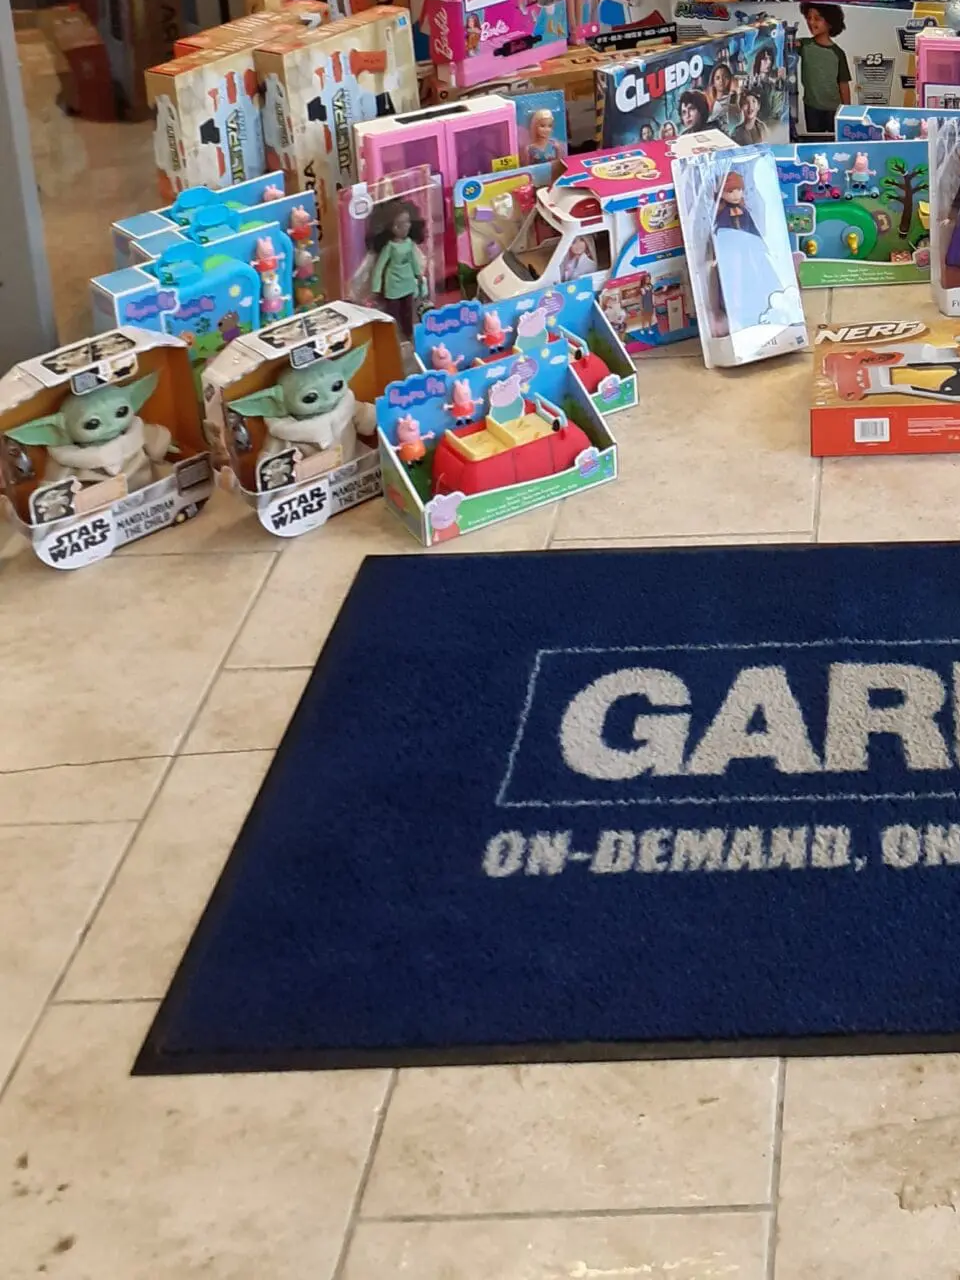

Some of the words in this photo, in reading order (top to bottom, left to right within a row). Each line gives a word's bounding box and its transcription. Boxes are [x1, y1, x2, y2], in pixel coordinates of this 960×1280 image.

[866, 53, 883, 66] 25
[814, 320, 926, 345] NERF
[271, 486, 326, 519] STAR
[271, 496, 327, 531] WARS
[48, 517, 110, 553] STAR
[49, 526, 111, 564] WARS
[482, 825, 868, 880] ON-DEMAND,
